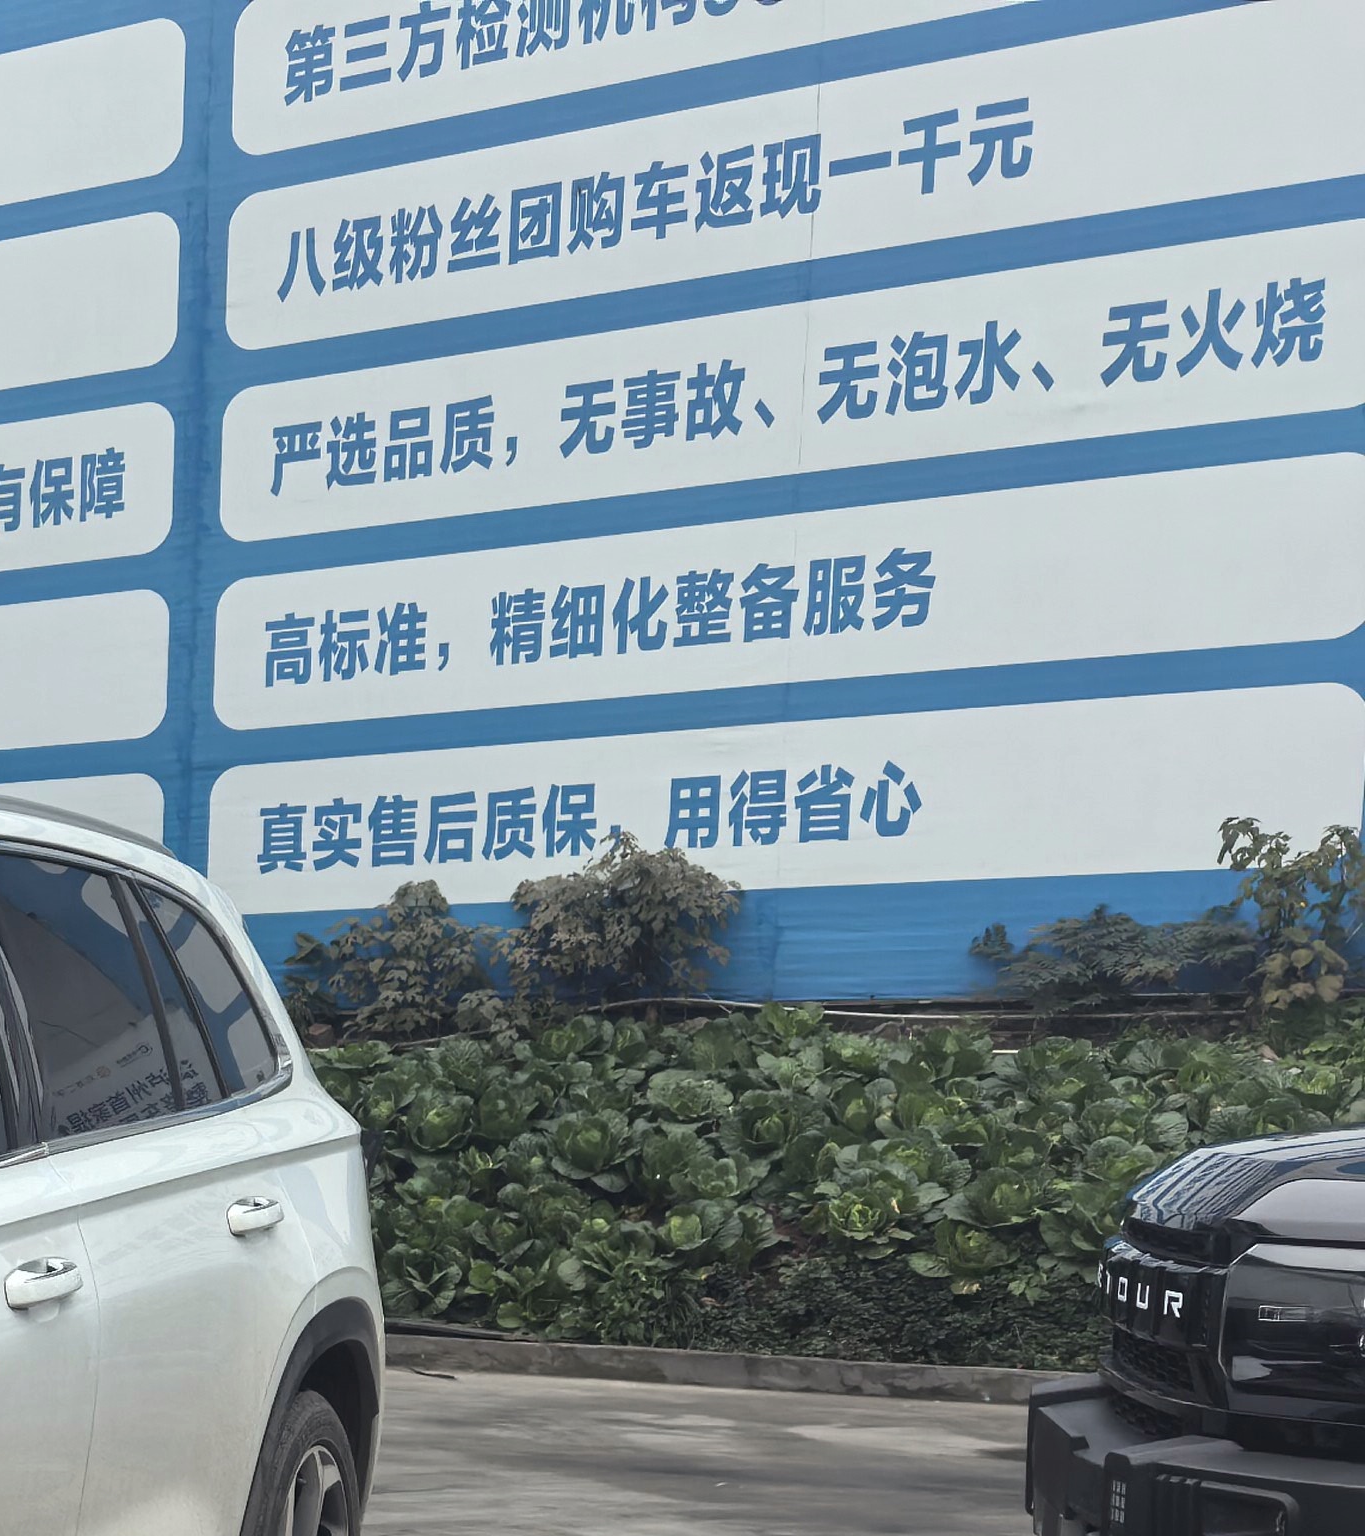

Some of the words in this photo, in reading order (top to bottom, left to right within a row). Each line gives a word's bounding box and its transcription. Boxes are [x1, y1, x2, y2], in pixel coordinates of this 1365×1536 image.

[284, 0, 782, 105] 第三方检测机
[276, 97, 1034, 302] 八级粉丝团购车返现一千元
[270, 277, 1327, 496] 严选品质，无事故、无泡水、无火烧
[264, 548, 937, 688] 高标准，精细化整备服务
